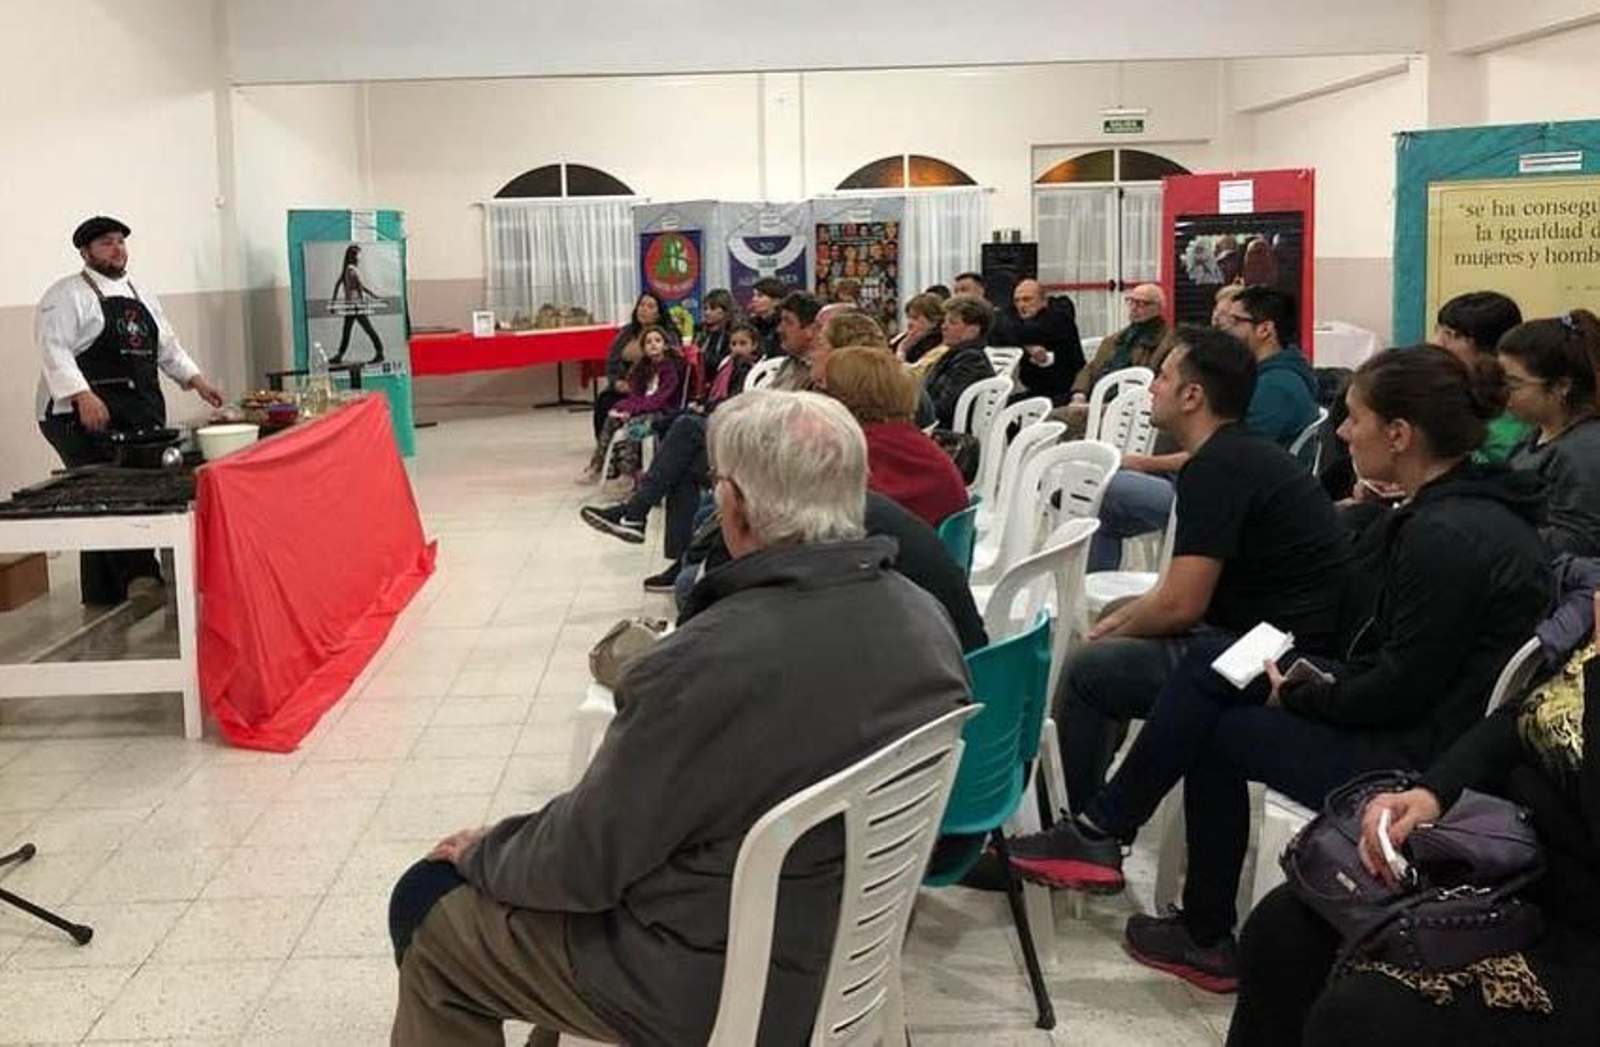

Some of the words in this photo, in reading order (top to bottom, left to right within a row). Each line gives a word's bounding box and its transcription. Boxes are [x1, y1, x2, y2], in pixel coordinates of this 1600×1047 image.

[1492, 199, 1516, 216] ha
[1475, 224, 1492, 241] la
[1500, 221, 1583, 244] igualdad
[1454, 251, 1524, 268] mujeres
[1529, 252, 1540, 269] y
